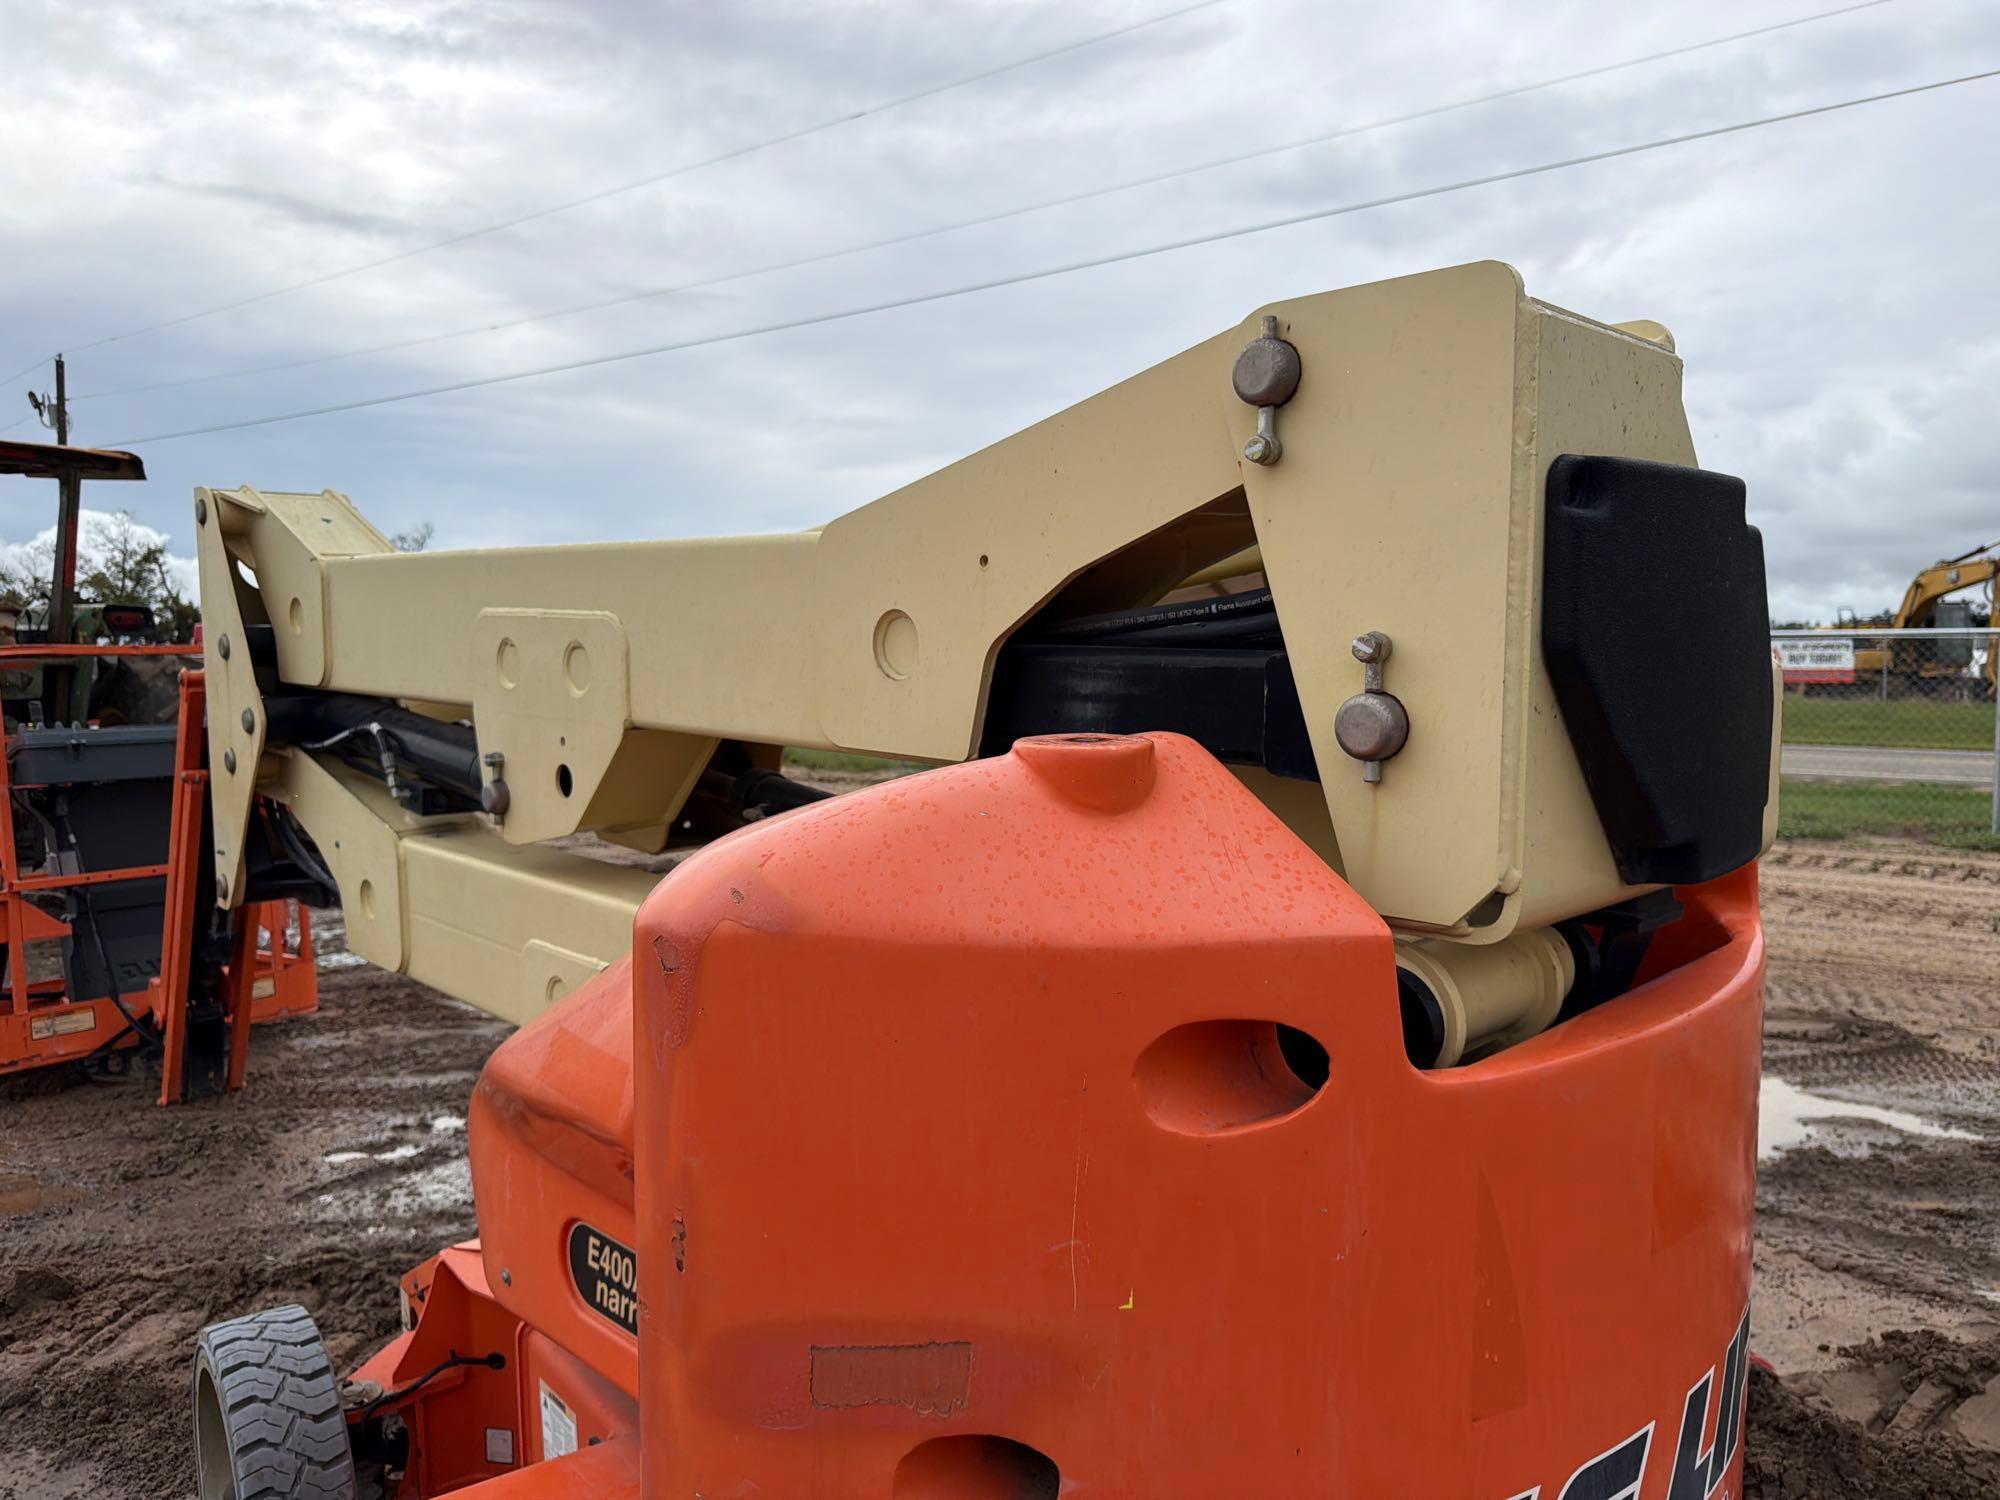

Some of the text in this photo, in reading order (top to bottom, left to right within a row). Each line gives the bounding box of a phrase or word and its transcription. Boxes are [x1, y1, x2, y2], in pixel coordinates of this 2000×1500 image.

[1192, 607, 1204, 617] Type
[1218, 603, 1235, 611] Flame
[588, 1235, 637, 1293] E400
[596, 1279, 637, 1324] narr
